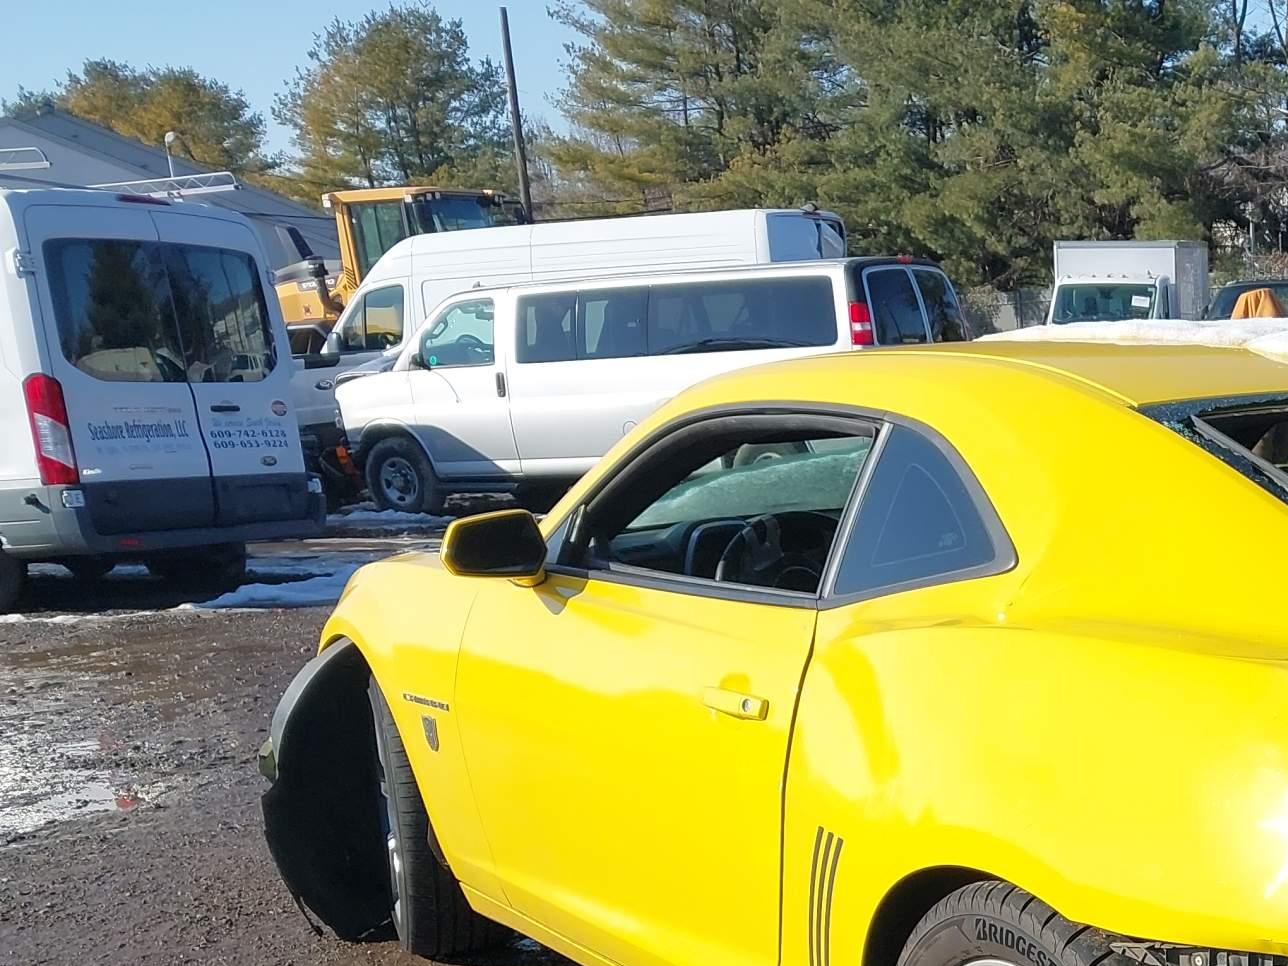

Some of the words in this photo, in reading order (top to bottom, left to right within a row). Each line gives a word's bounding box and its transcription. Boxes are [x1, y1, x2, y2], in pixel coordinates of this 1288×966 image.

[87, 421, 126, 441] Seashore
[124, 419, 177, 443] Refrigeration,
[174, 419, 189, 438] LLC
